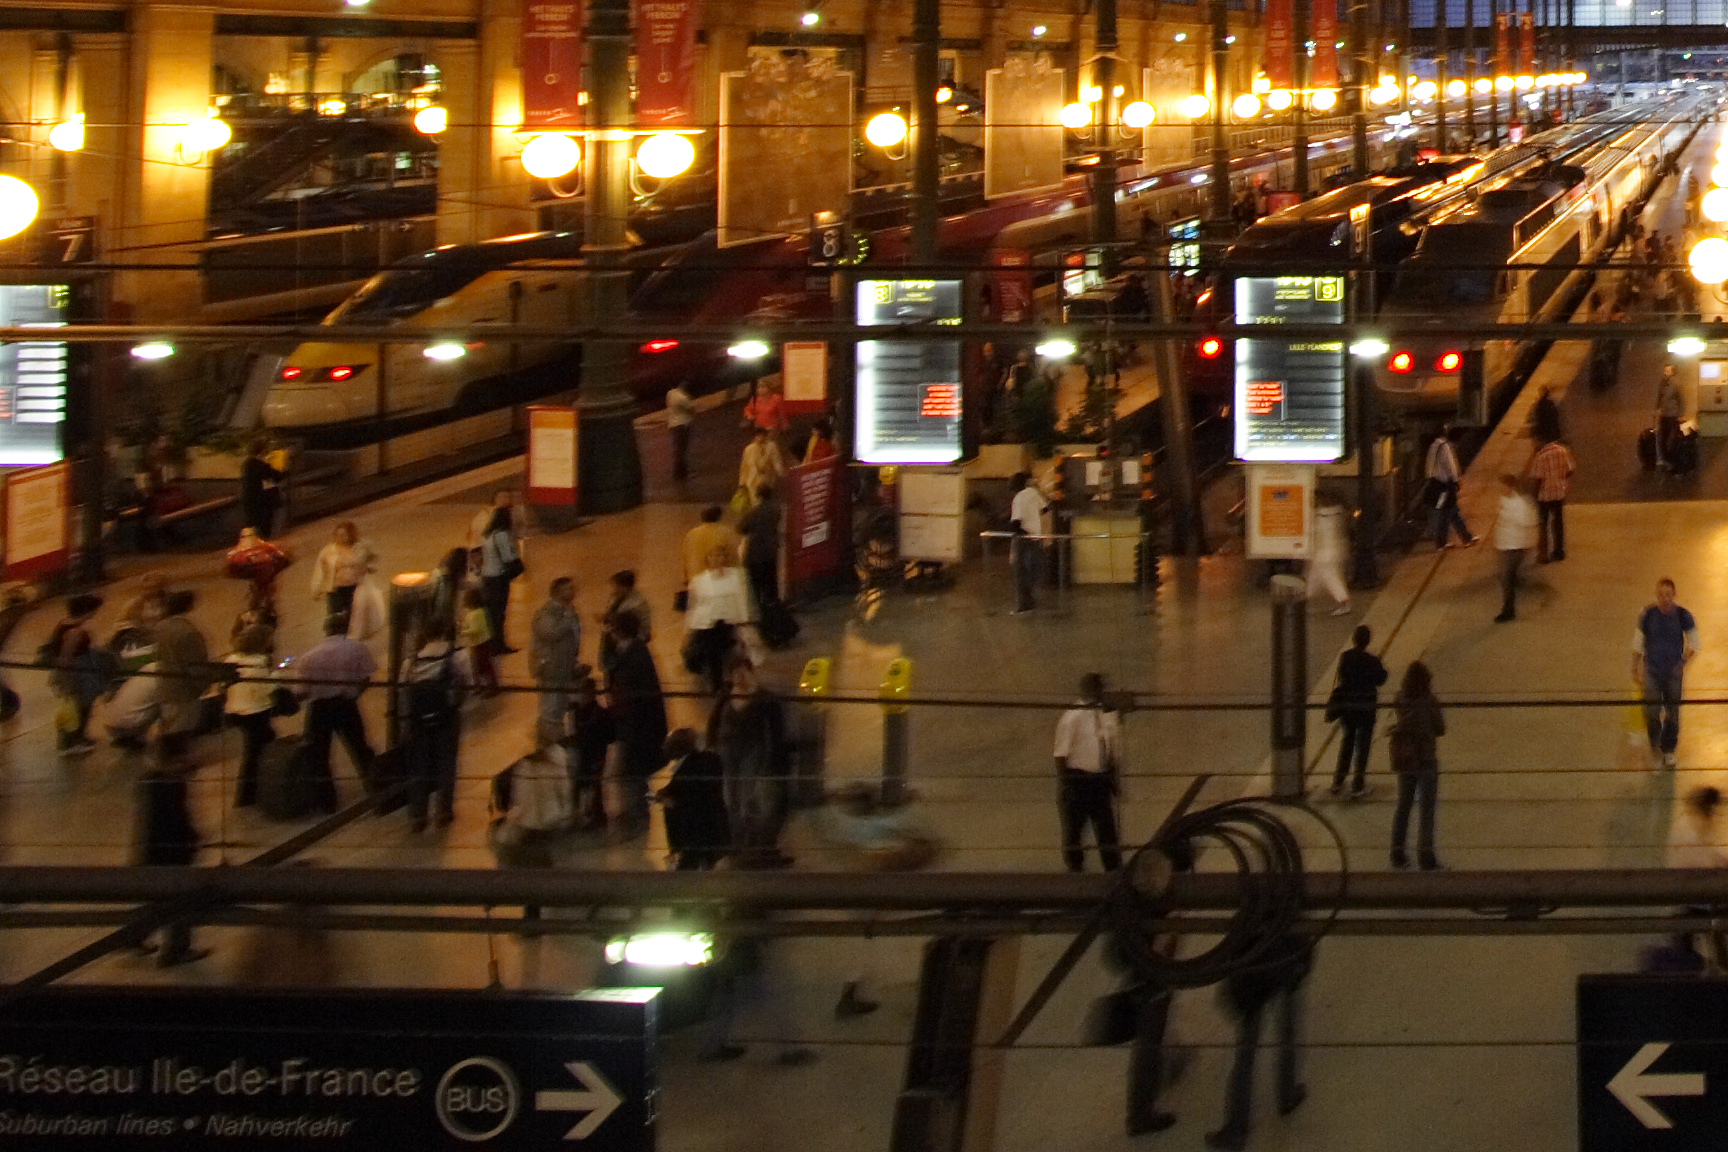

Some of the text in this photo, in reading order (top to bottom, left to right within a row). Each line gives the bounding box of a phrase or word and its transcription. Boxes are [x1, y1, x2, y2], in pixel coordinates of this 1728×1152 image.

[59, 234, 83, 262] 7
[1322, 284, 1336, 299] 9
[152, 1057, 422, 1097] Ile-de-France
[447, 1087, 505, 1113] BUS
[116, 1113, 177, 1136] lines
[205, 1114, 355, 1138] Nahverkehr
